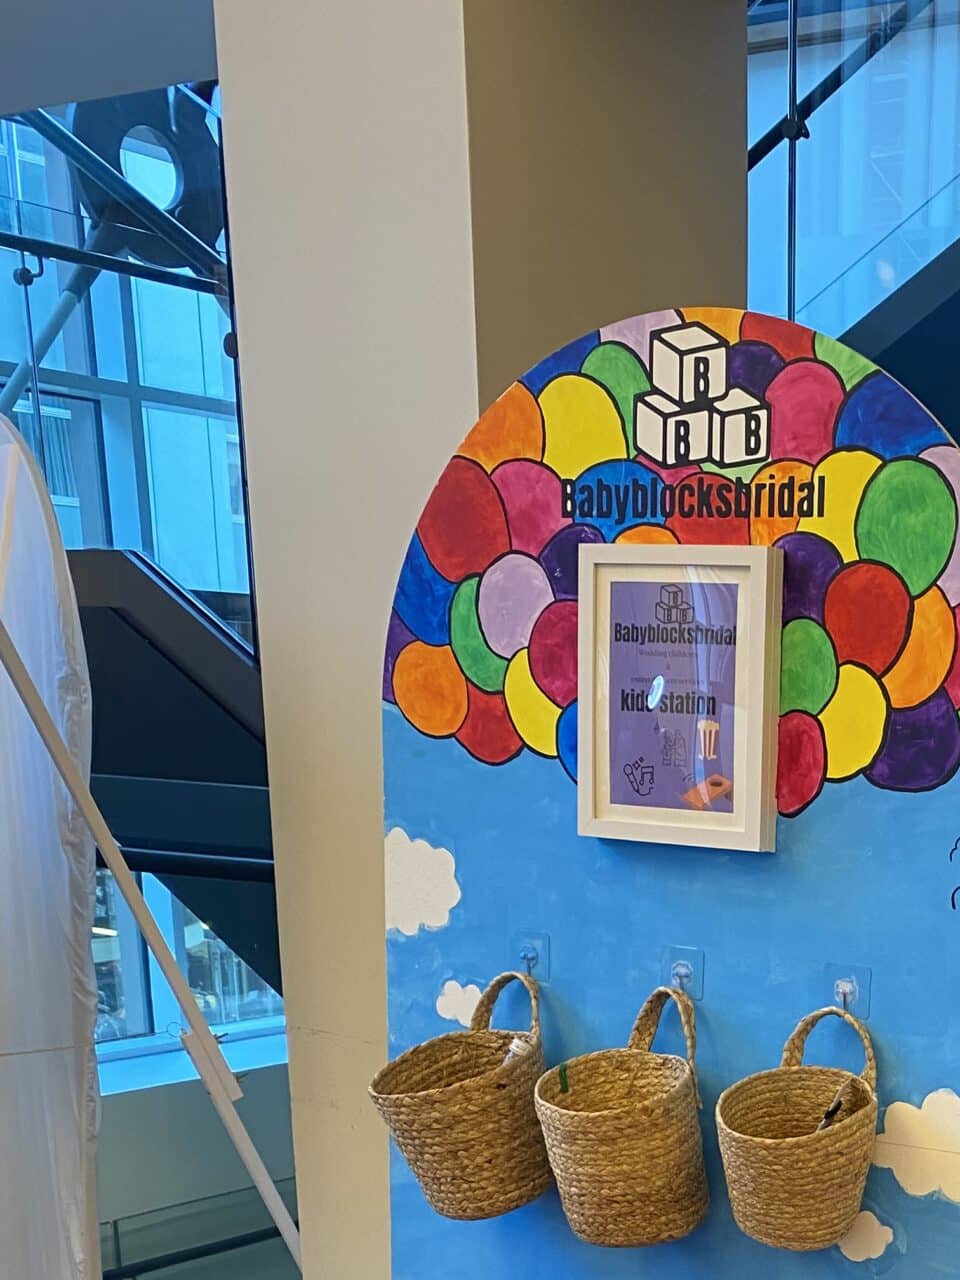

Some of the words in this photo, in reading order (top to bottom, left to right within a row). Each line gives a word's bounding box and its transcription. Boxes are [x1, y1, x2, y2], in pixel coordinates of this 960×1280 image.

[693, 356, 710, 396] B
[675, 420, 690, 462] B
[745, 413, 761, 456] B
[561, 475, 826, 526] Babyblocksbridal
[614, 622, 736, 646] Babyblocksbridal
[660, 692, 716, 715] station
